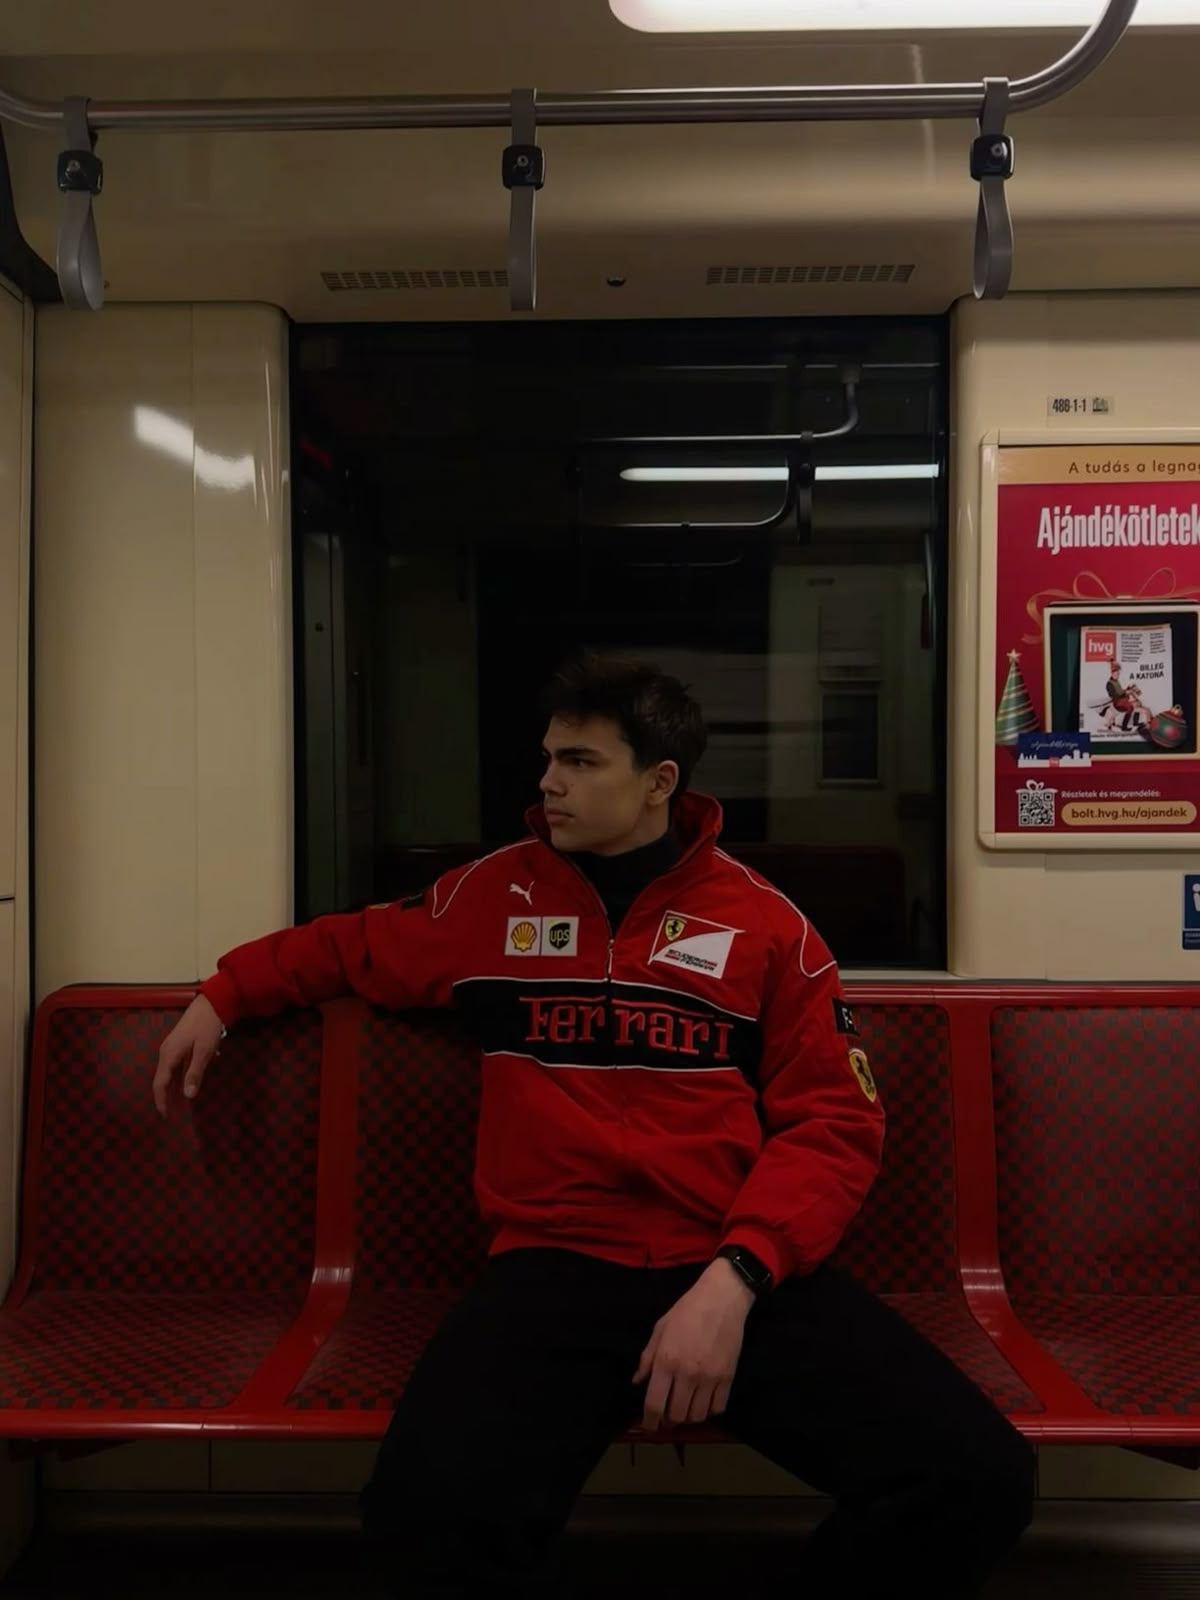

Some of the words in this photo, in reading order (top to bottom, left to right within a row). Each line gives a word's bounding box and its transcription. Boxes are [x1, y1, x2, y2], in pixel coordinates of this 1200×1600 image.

[1068, 462, 1079, 474] A
[1085, 460, 1130, 474] tudás
[1136, 464, 1146, 473] a
[1152, 459, 1200, 475] legna
[1037, 504, 1200, 555] Ajándékötletek
[1087, 639, 1114, 656] hvg
[1129, 672, 1135, 680] A
[1136, 671, 1164, 680] KATONA
[1071, 807, 1187, 820] bolt.hvg.hu/ajandek
[550, 927, 570, 944] ups
[519, 996, 734, 1059] Ferrari
